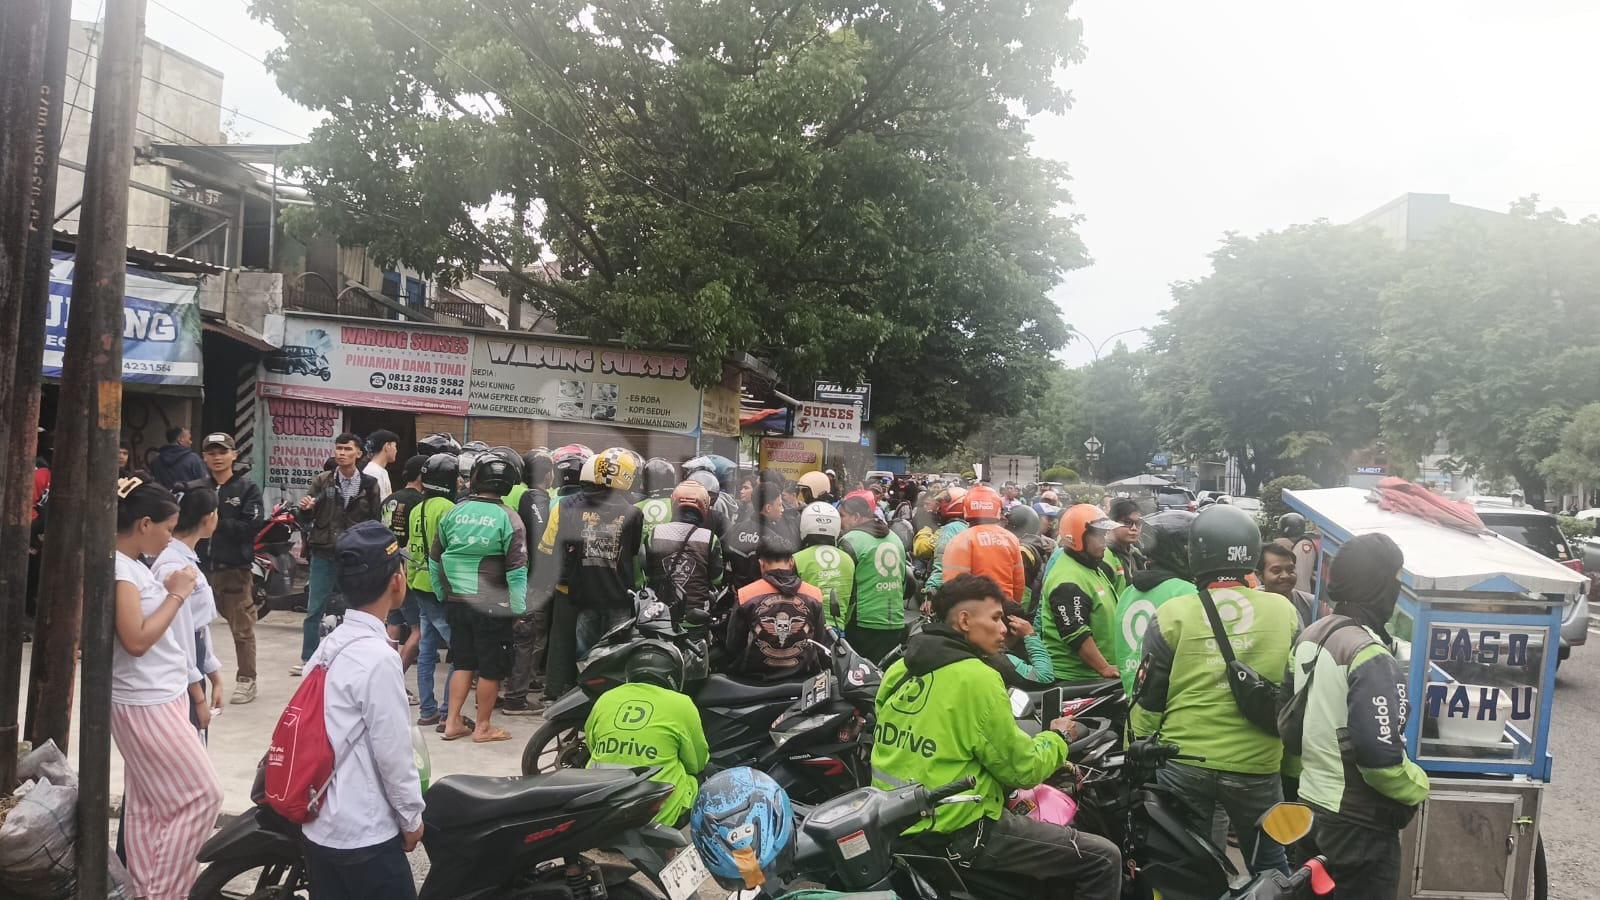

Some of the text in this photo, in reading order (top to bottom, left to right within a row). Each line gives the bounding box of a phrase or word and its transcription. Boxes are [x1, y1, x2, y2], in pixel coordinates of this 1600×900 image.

[341, 326, 469, 355] WARUNG SUKSES
[346, 353, 467, 376] PINJAMAN DANA TUNAI
[487, 341, 689, 381] WARUNG SUKSES
[472, 368, 494, 377] SEDIA
[388, 373, 465, 388] 0812 2035 9582
[470, 380, 515, 391] NASI KUNING
[387, 382, 463, 397] 0813 8896 2444
[468, 391, 546, 404] AYAM GEPREK CRISPY
[630, 394, 661, 404] ES BOBA
[267, 400, 340, 420] WARUNG
[468, 402, 552, 416] AYAM GEPREK ORIGINAL
[628, 406, 671, 416] KOPI SEDUH
[803, 405, 854, 421] SUKSES
[272, 416, 335, 438] SUKSES
[626, 416, 688, 429] MINUMAN DINGIN
[813, 420, 853, 431] TAILOR
[273, 446, 333, 458] PINJAMAN
[268, 455, 301, 467] DANA
[270, 467, 290, 476] 0812
[291, 469, 313, 477] 2035
[738, 531, 760, 543] Grab
[875, 580, 902, 592] gojek
[1428, 628, 1530, 667] BASO
[1426, 684, 1533, 721] TAHU
[1372, 695, 1393, 744] gopay
[595, 737, 658, 760] inDrive
